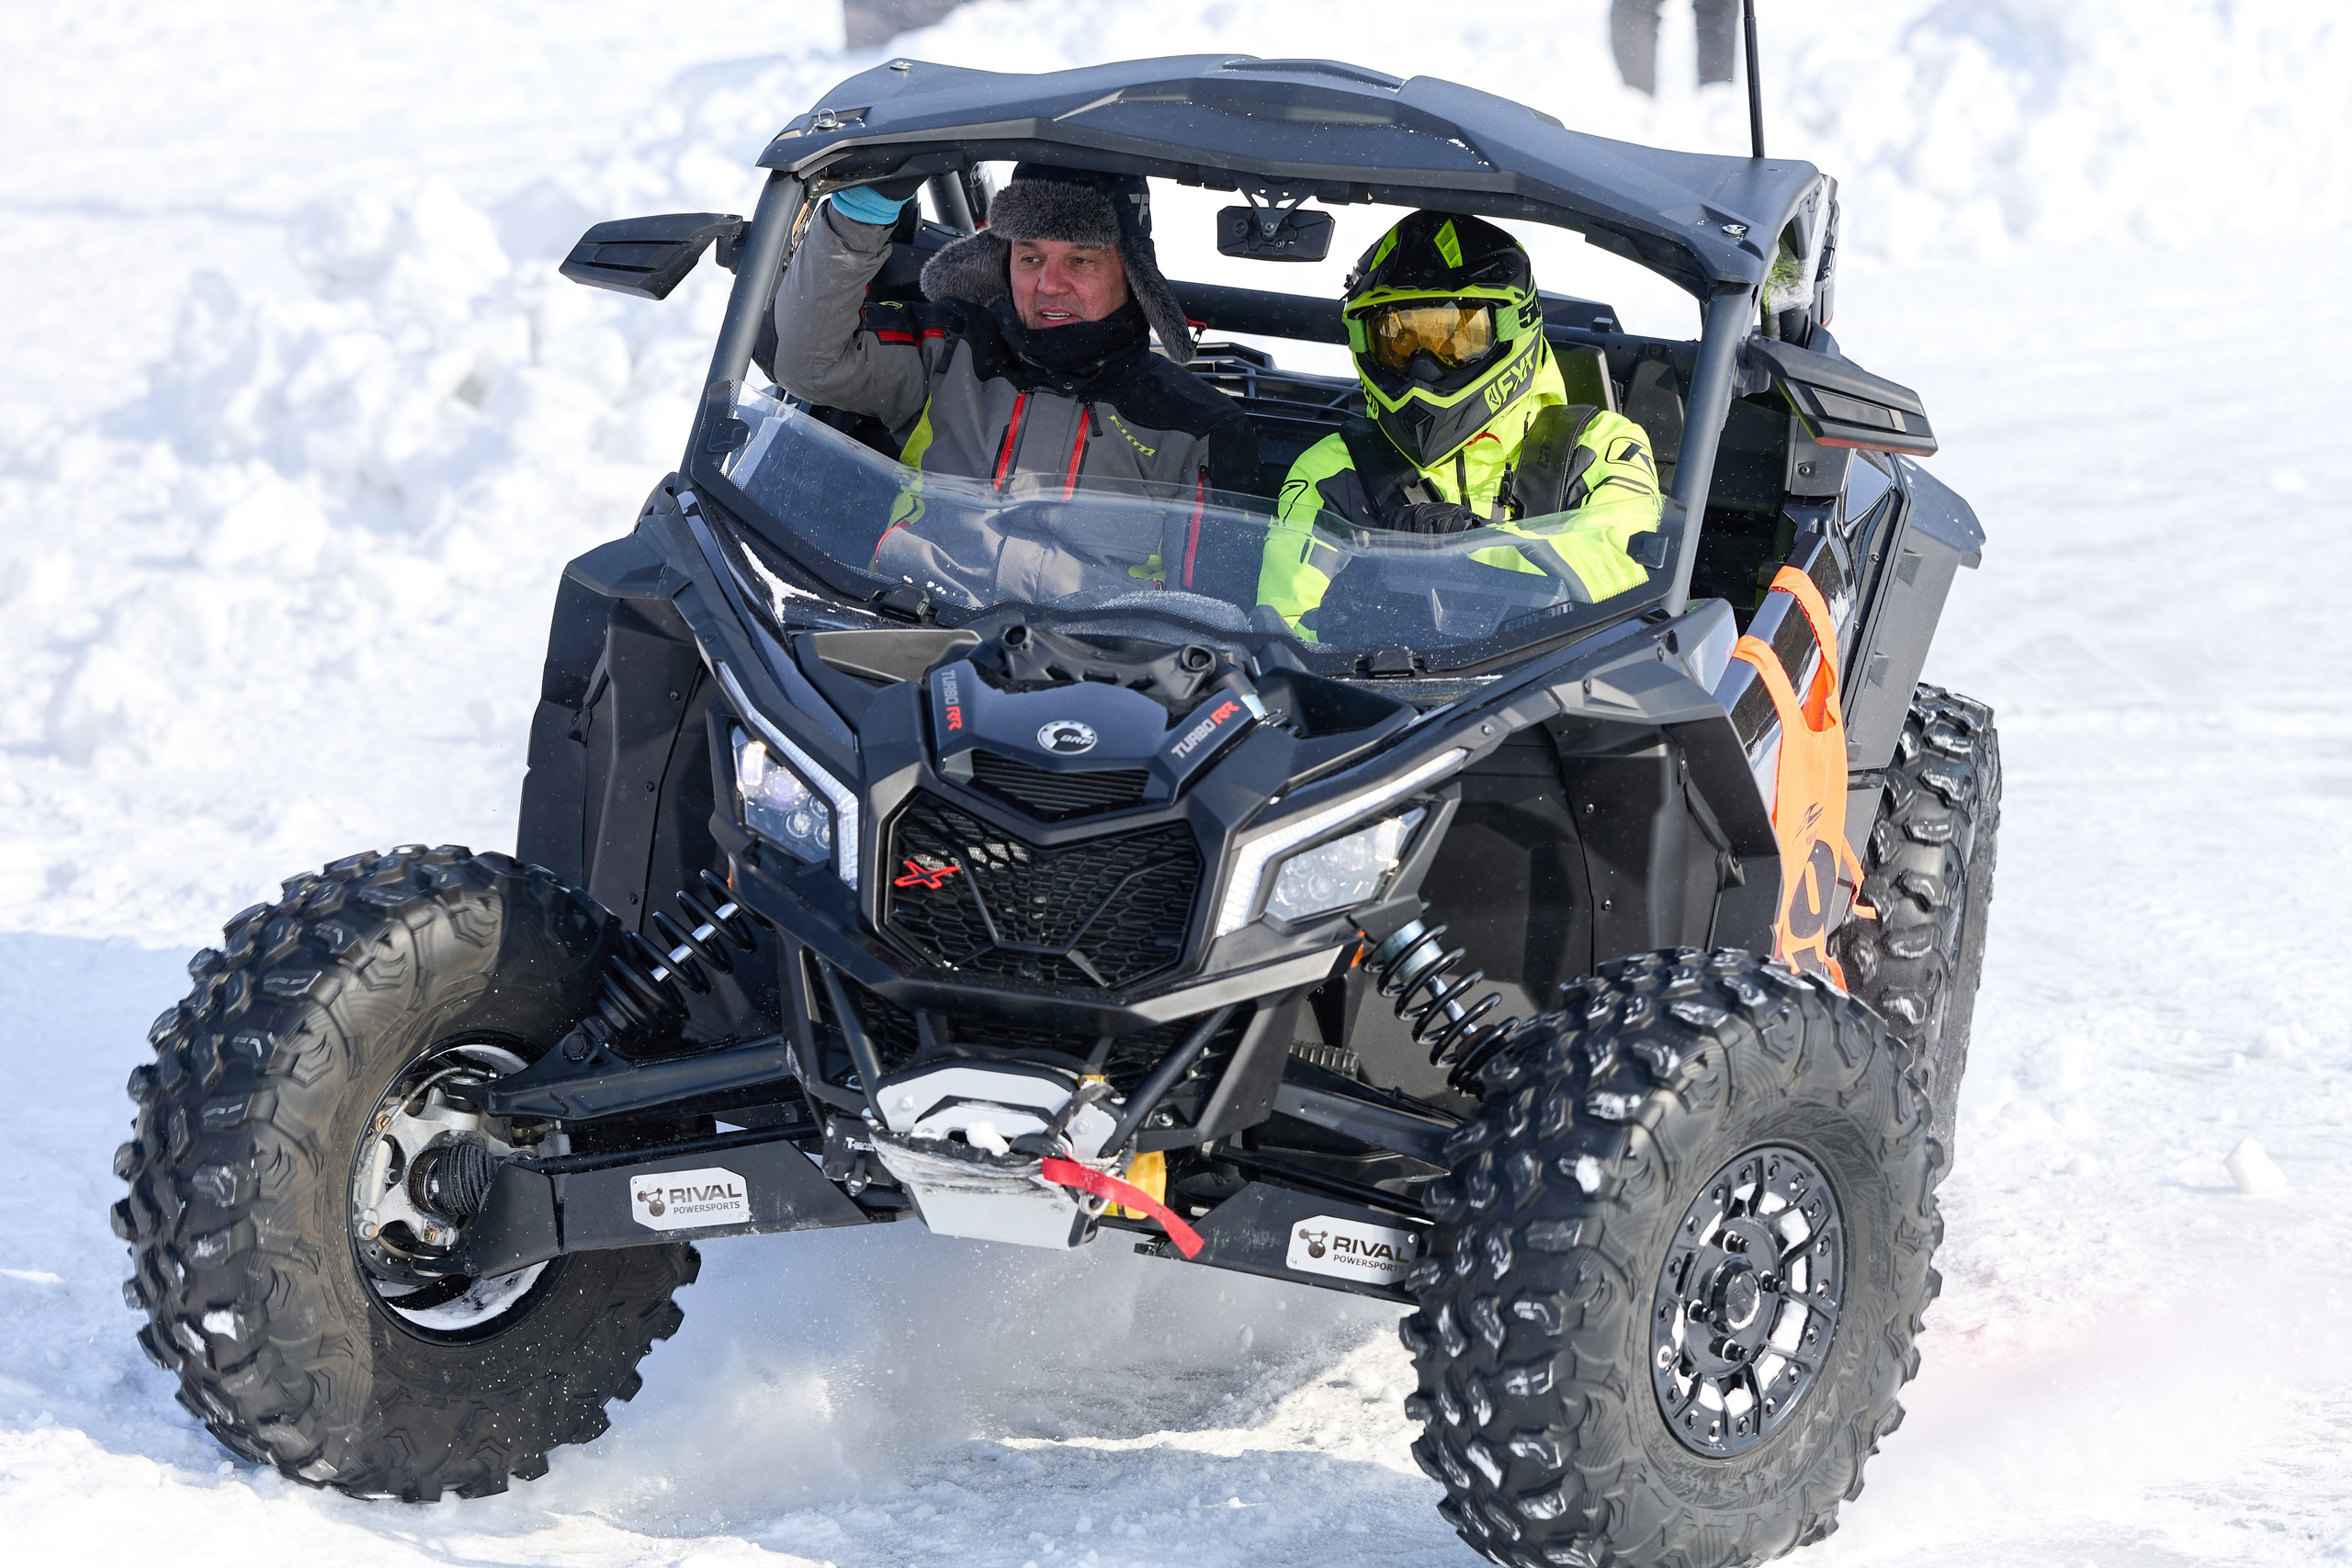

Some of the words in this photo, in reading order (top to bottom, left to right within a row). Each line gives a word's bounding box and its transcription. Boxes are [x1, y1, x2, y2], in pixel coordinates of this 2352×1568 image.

[942, 669, 959, 705] TURBO
[945, 705, 963, 732] RR
[1170, 717, 1216, 759] TURBO
[1210, 700, 1240, 725] RR
[669, 1183, 742, 1204] RIVAL
[673, 1201, 741, 1214] POWERSPORTS
[1332, 1235, 1410, 1263] RIVAL
[1333, 1255, 1406, 1274] POWERSPORTS
